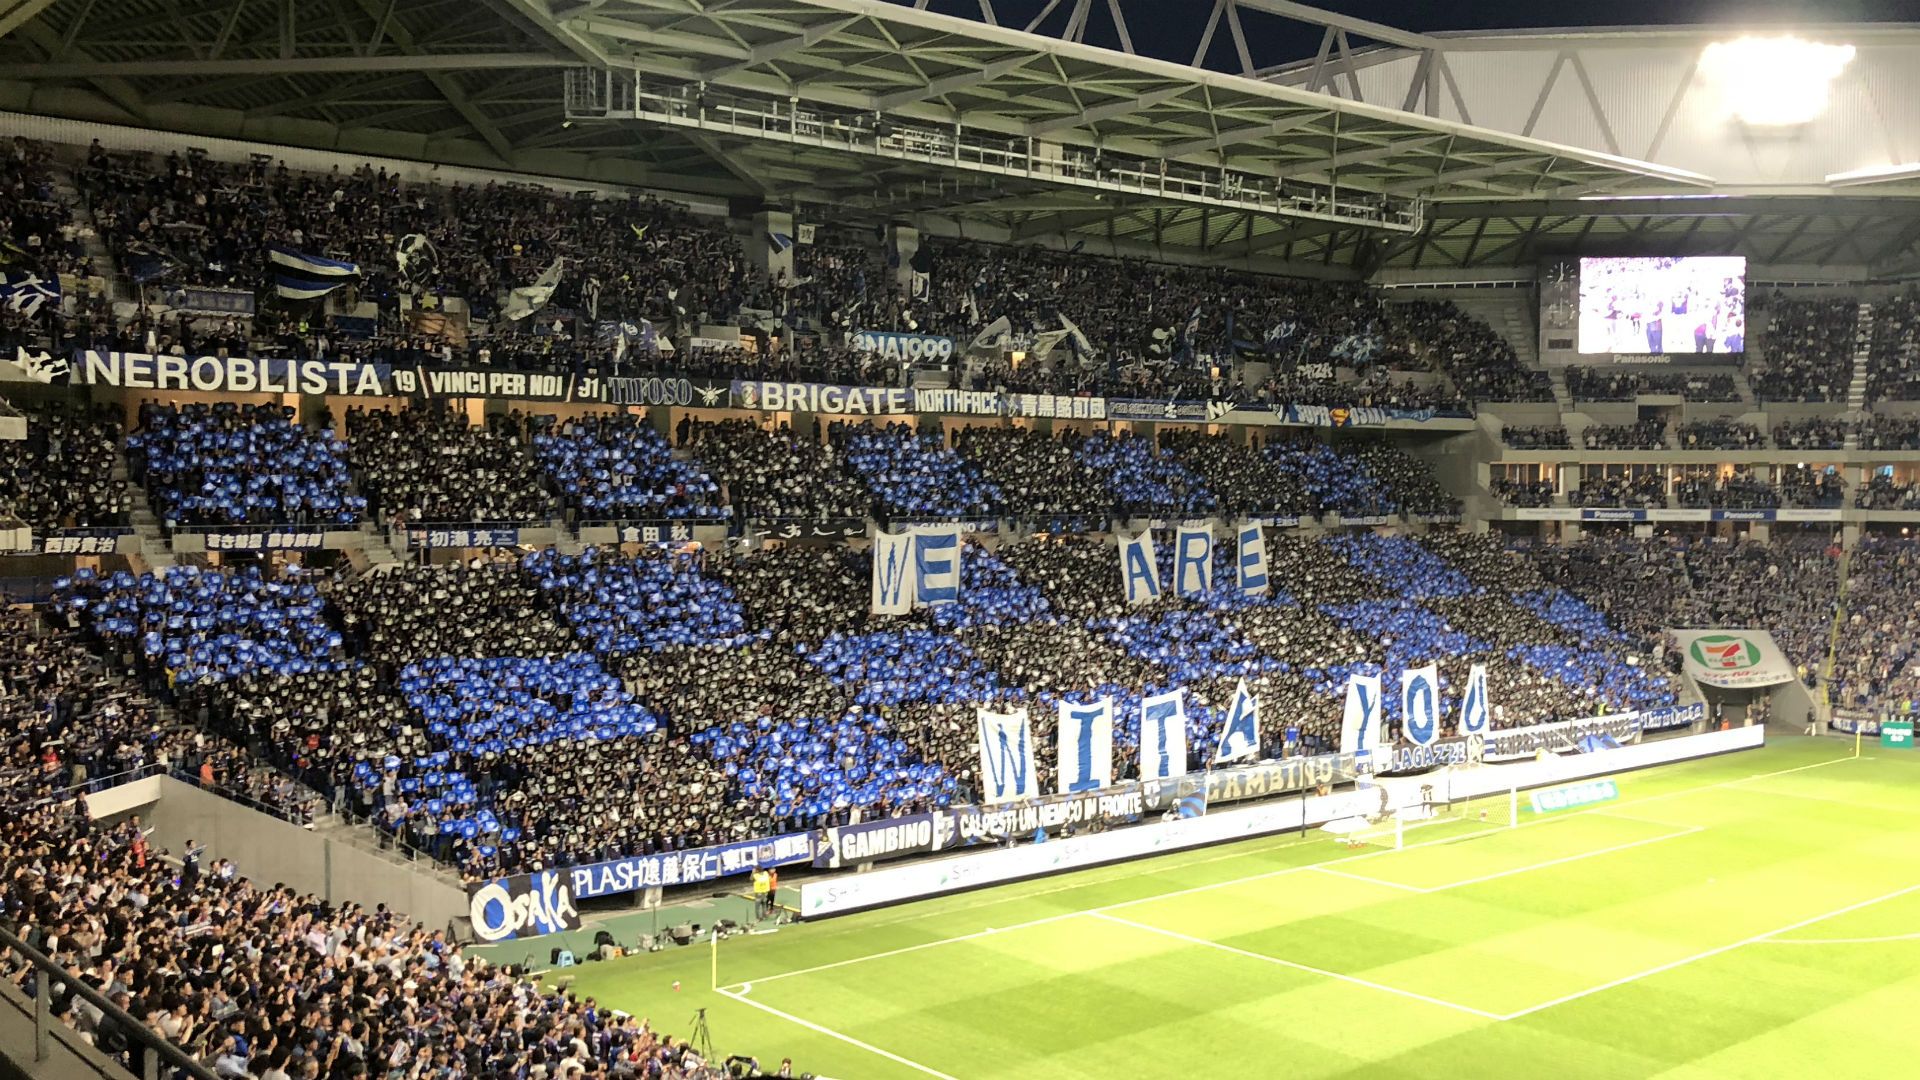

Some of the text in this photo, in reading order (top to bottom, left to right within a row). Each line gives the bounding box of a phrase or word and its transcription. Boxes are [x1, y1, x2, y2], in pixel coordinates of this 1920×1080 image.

[84, 350, 384, 396] NEROBLISTA
[1613, 354, 1671, 365] Panasonic
[392, 370, 415, 392] 19
[430, 371, 486, 395] VINCI
[490, 373, 526, 396] PER
[529, 374, 563, 397] NOI
[607, 375, 693, 406] TIFOSO
[762, 382, 906, 415] BRIGATE
[1595, 509, 1635, 519] Panasonic
[1724, 510, 1765, 519] Panasonic
[877, 528, 1268, 606] WE ARE
[1208, 757, 1333, 801] GAMBINO
[842, 820, 931, 860] GAMBINO
